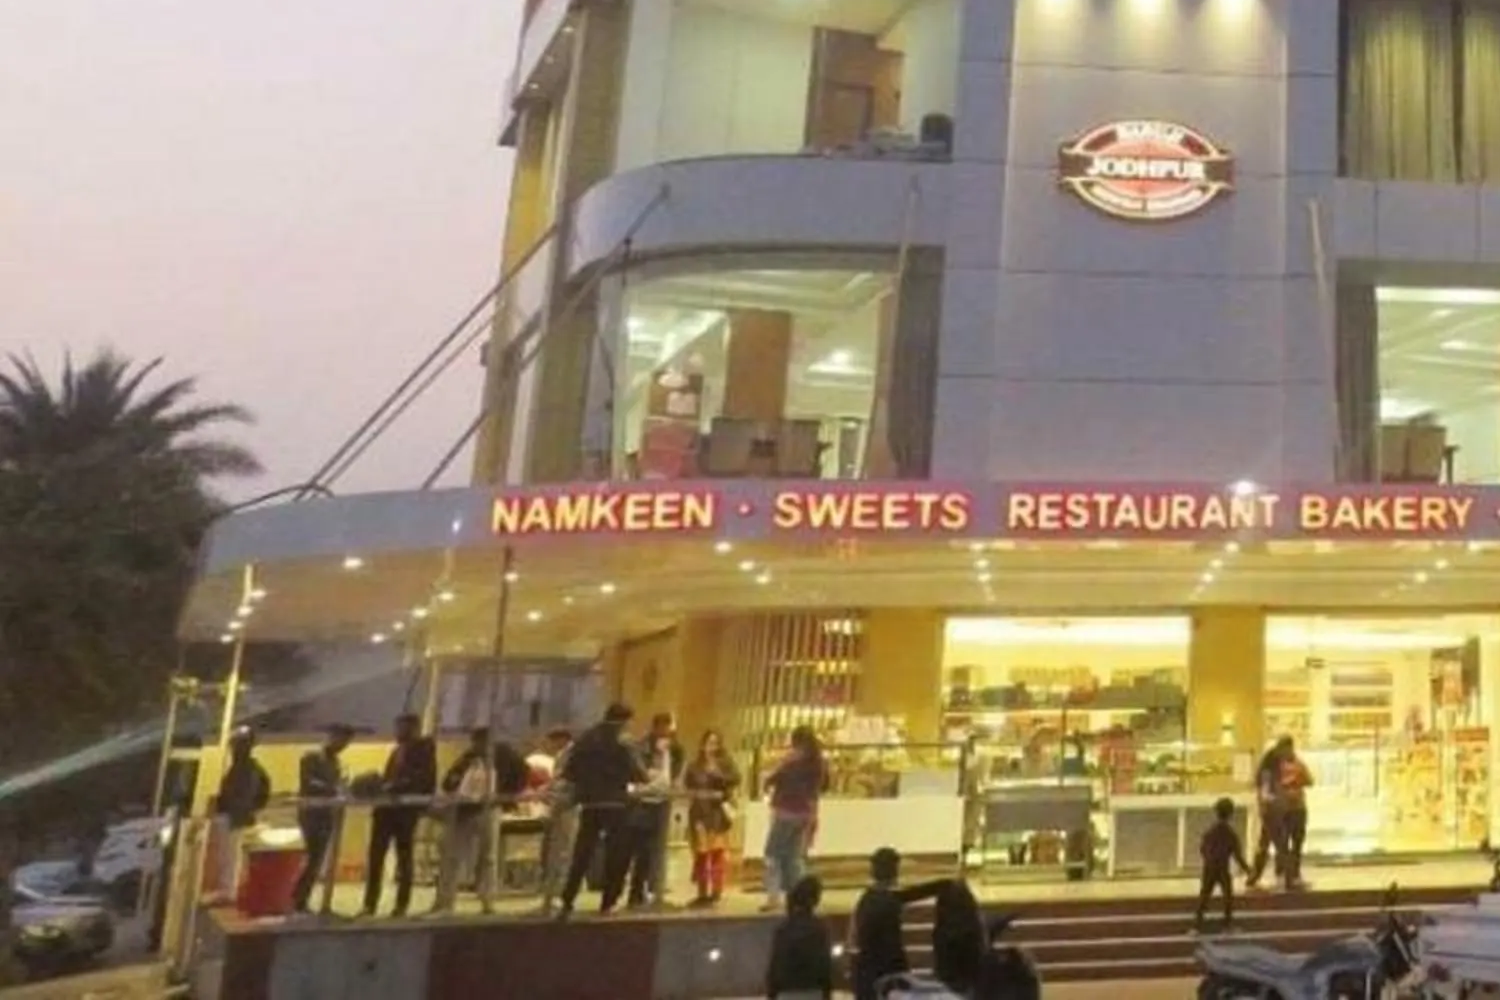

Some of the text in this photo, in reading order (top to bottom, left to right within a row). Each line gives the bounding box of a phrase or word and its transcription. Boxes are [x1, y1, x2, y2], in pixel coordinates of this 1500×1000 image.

[1086, 156, 1205, 180] JODHPUR
[491, 493, 714, 533] NAMKEEN
[773, 492, 969, 529] SWEETS
[1008, 492, 1280, 530] RESTAURANT
[1301, 495, 1473, 530] BAKERY
